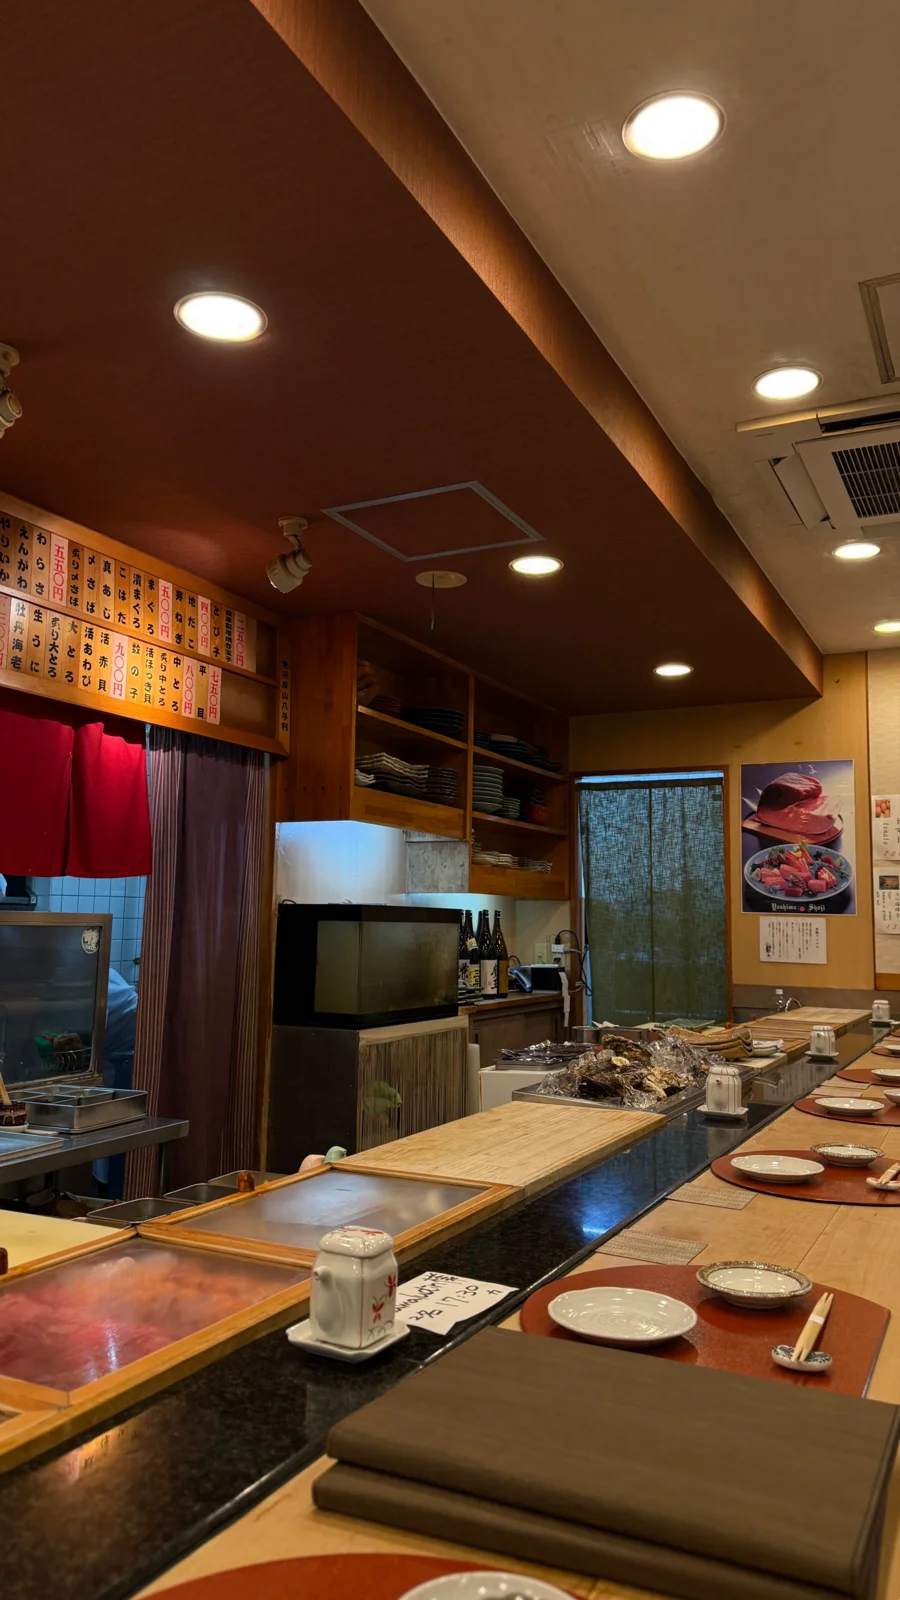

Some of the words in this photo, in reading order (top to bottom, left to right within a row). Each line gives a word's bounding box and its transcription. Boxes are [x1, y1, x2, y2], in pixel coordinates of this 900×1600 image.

[17, 526, 28, 589] えんがわ
[35, 532, 47, 595] わらさ
[52, 544, 66, 602] 五五〇円
[102, 560, 112, 620] 真あじ
[117, 566, 127, 625] こはだ
[132, 573, 142, 630] 漬まぐろ
[147, 579, 156, 635] まぐろ
[160, 585, 170, 639] 五〇〇円
[11, 602, 26, 670] 牡丹海老
[29, 609, 43, 673] 生うに
[187, 595, 196, 649] 地だこ
[200, 601, 209, 649] 四〇〇円
[64, 621, 78, 683] 大とろ
[81, 627, 94, 687] 活あわび
[98, 632, 109, 692] 活赤貝
[112, 642, 125, 697] 九〇〇円
[129, 642, 140, 699] 数の子
[171, 656, 181, 712] 中とろ
[184, 664, 194, 715] 八〇〇円
[197, 665, 207, 719] 平目
[209, 671, 219, 719] 七五〇円
[771, 902, 797, 911] Yashima
[808, 903, 826, 912] Shoji
[435, 1284, 479, 1307] 17:30
